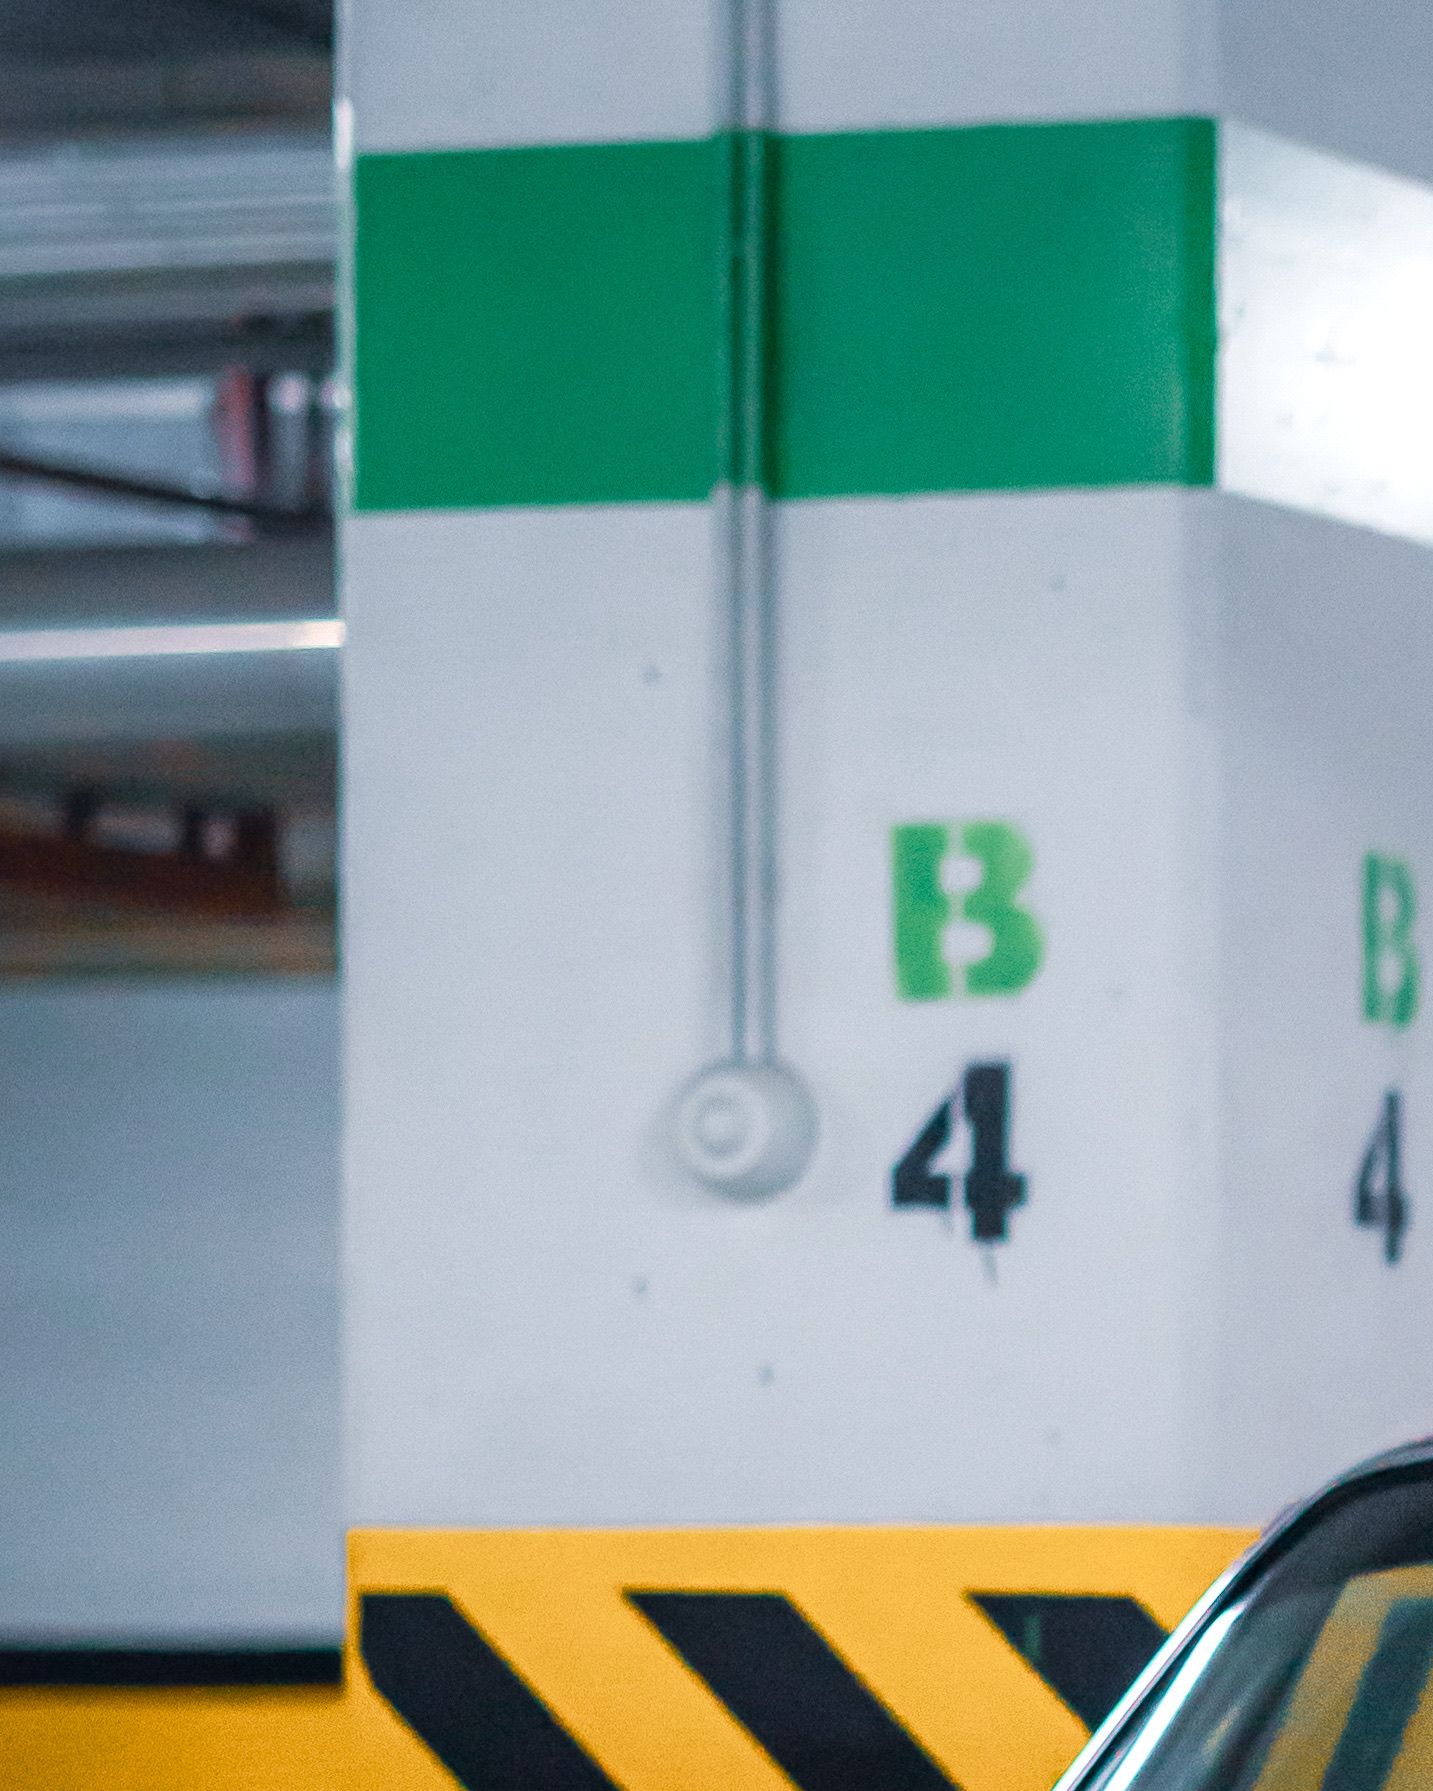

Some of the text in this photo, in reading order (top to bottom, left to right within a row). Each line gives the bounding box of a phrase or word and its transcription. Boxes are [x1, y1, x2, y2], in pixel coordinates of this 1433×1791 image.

[890, 820, 1047, 1002] B
[1361, 850, 1421, 1028] B
[889, 1060, 1028, 1243] 4
[1353, 1089, 1410, 1267] 4
